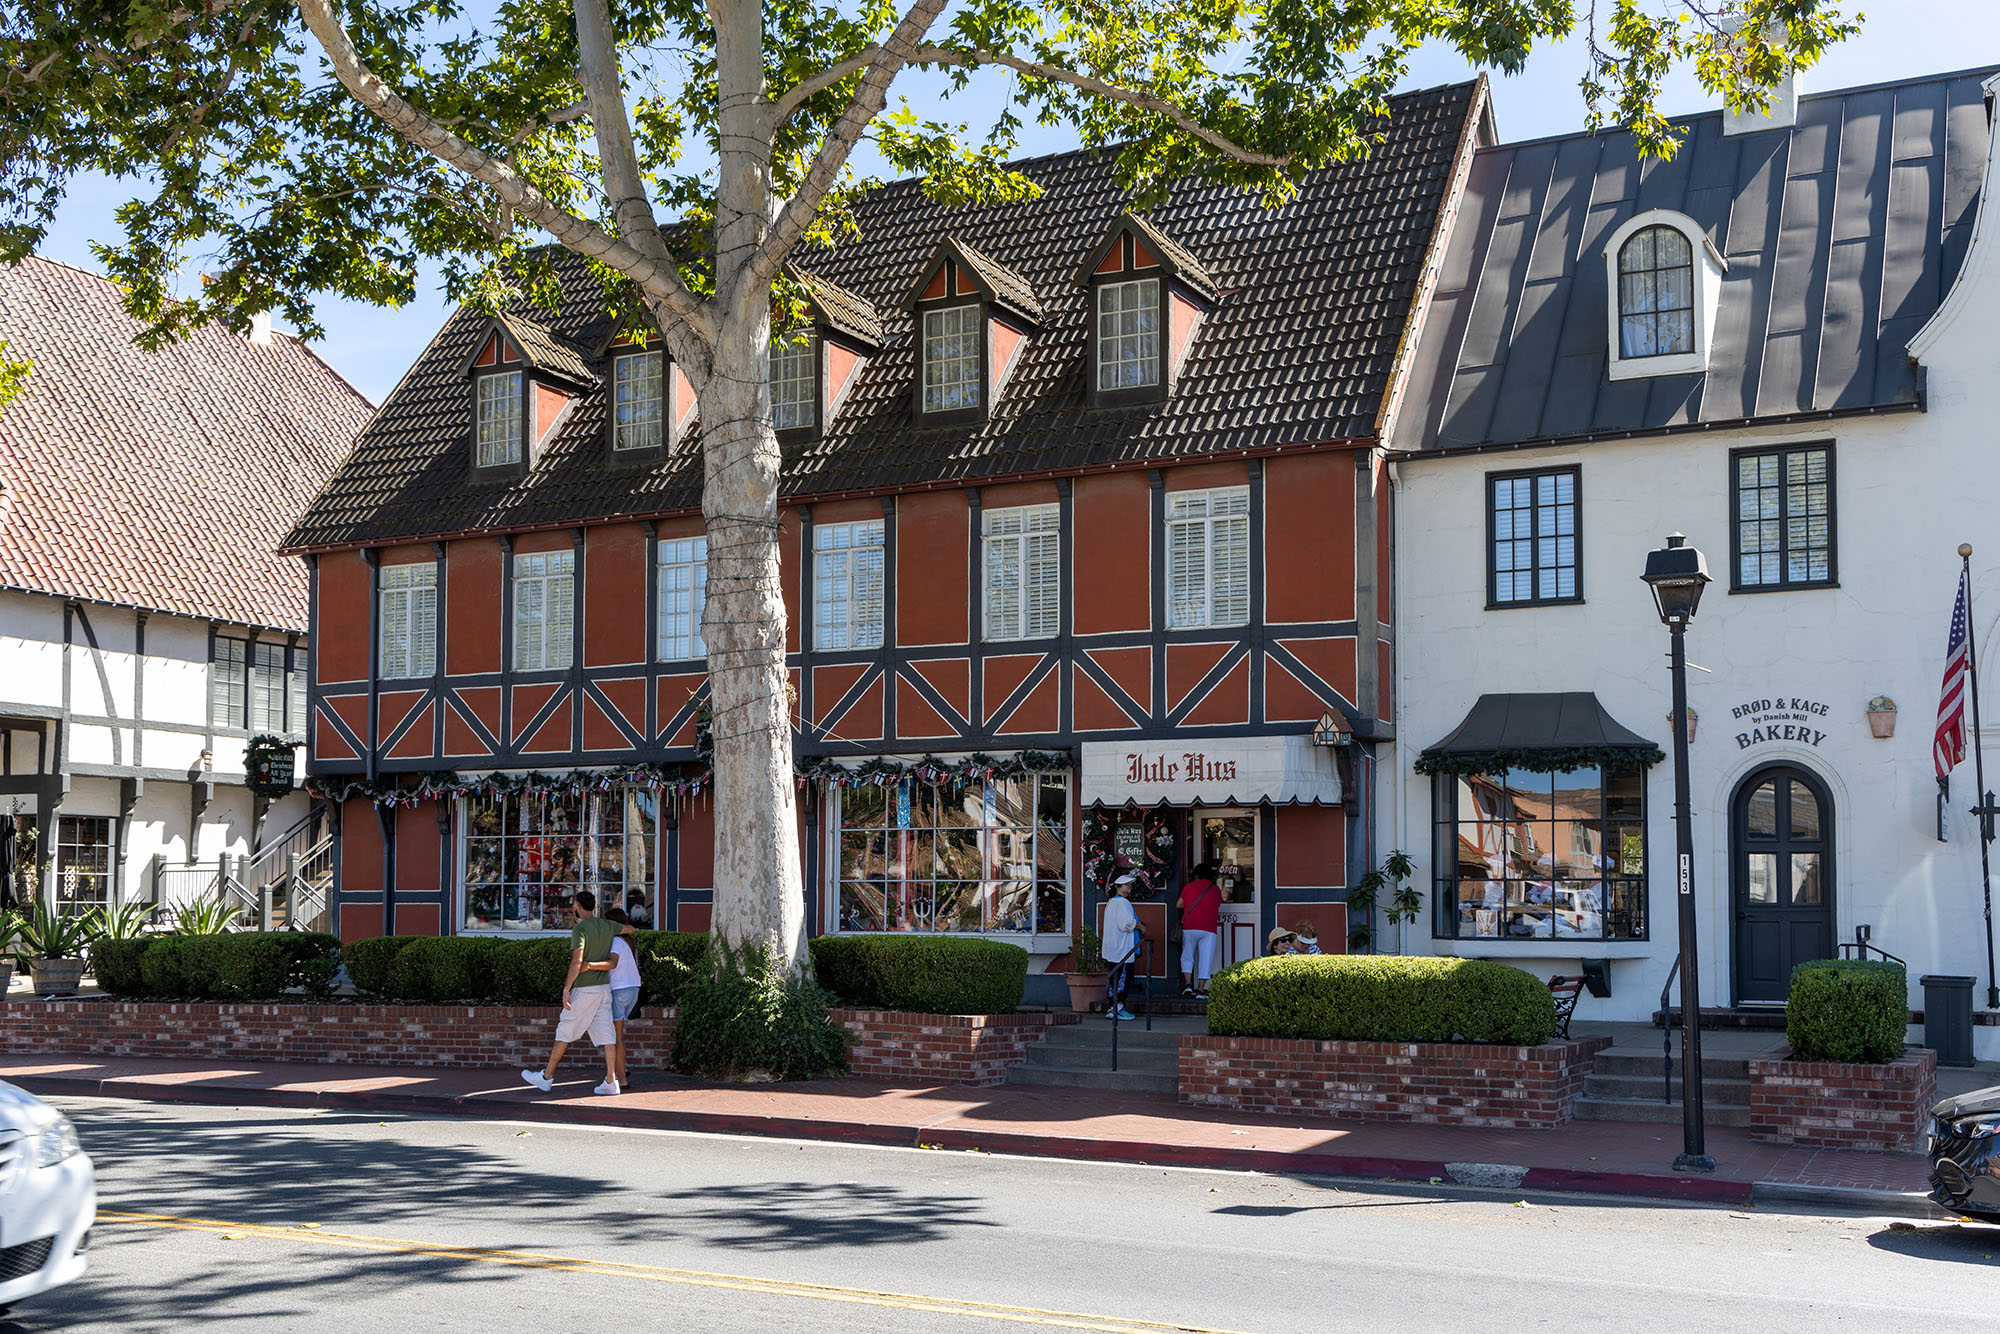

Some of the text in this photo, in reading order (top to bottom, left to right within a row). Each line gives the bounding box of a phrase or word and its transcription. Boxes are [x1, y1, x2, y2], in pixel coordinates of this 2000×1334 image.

[1732, 697, 1830, 720] BRØD & KAGE
[1752, 712, 1808, 724] by Danish Mill
[1735, 724, 1828, 750] BAKERY
[1126, 752, 1237, 784] Jule Hus
[1219, 866, 1238, 874] OPEN
